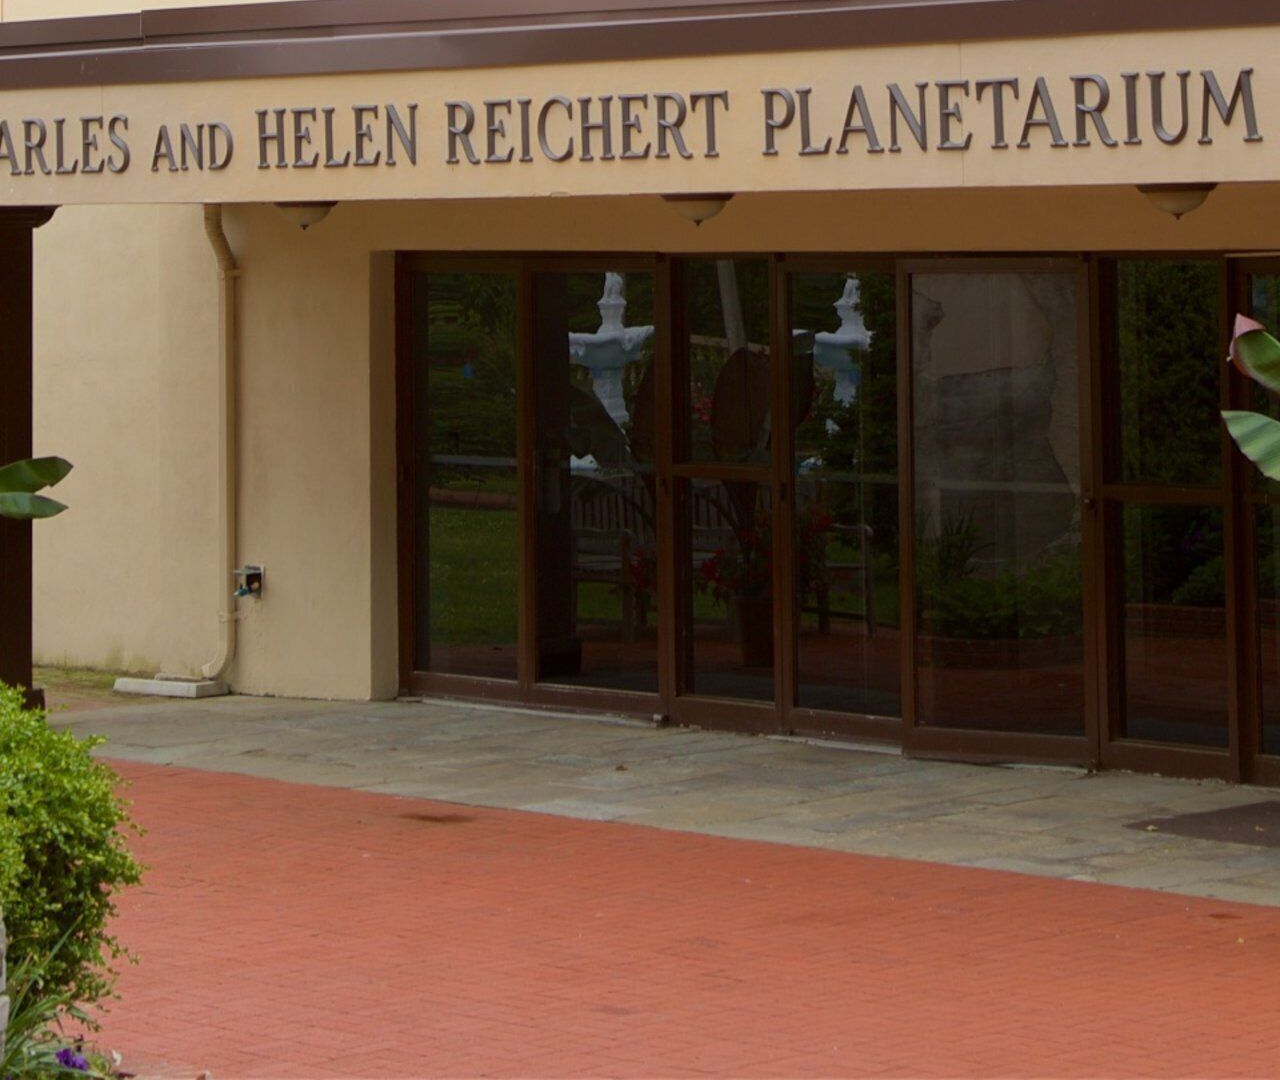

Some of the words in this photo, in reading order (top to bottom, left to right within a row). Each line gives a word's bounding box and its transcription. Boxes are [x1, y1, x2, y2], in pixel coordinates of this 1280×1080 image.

[151, 122, 234, 173] AND
[254, 103, 419, 170] HELEN
[444, 89, 730, 166] REICHERT
[761, 67, 1264, 157] PLANETARIUM
